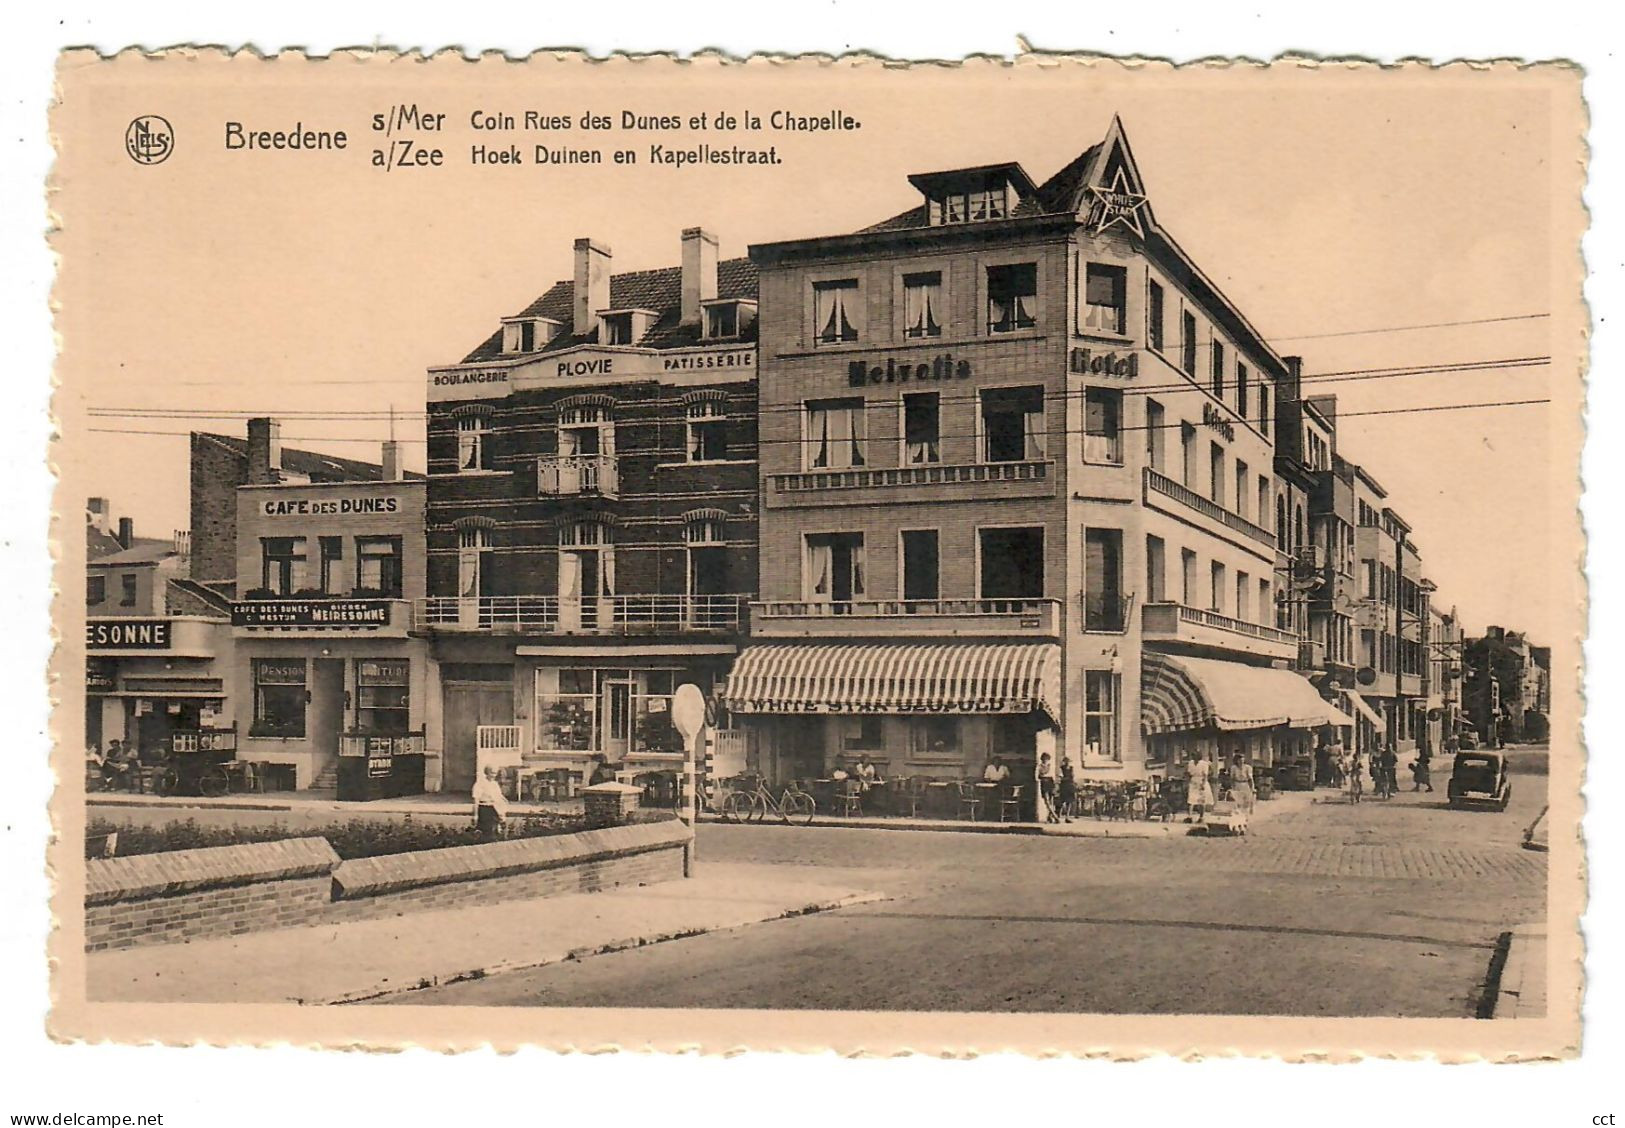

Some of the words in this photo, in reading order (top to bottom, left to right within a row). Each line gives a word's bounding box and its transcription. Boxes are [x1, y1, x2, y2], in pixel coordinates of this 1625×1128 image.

[557, 359, 612, 377] PLOVIE
[664, 353, 752, 370] PATISSERIE
[1070, 347, 1139, 378] Hotel
[434, 371, 508, 386] BOULANGERIE
[849, 354, 972, 387] Helvetia
[265, 500, 309, 514] CAFE
[312, 502, 338, 513] DES
[341, 498, 397, 513] DUNES
[260, 605, 278, 613] DES
[281, 605, 309, 613] DUNES
[312, 609, 385, 622] MEIRESONNE
